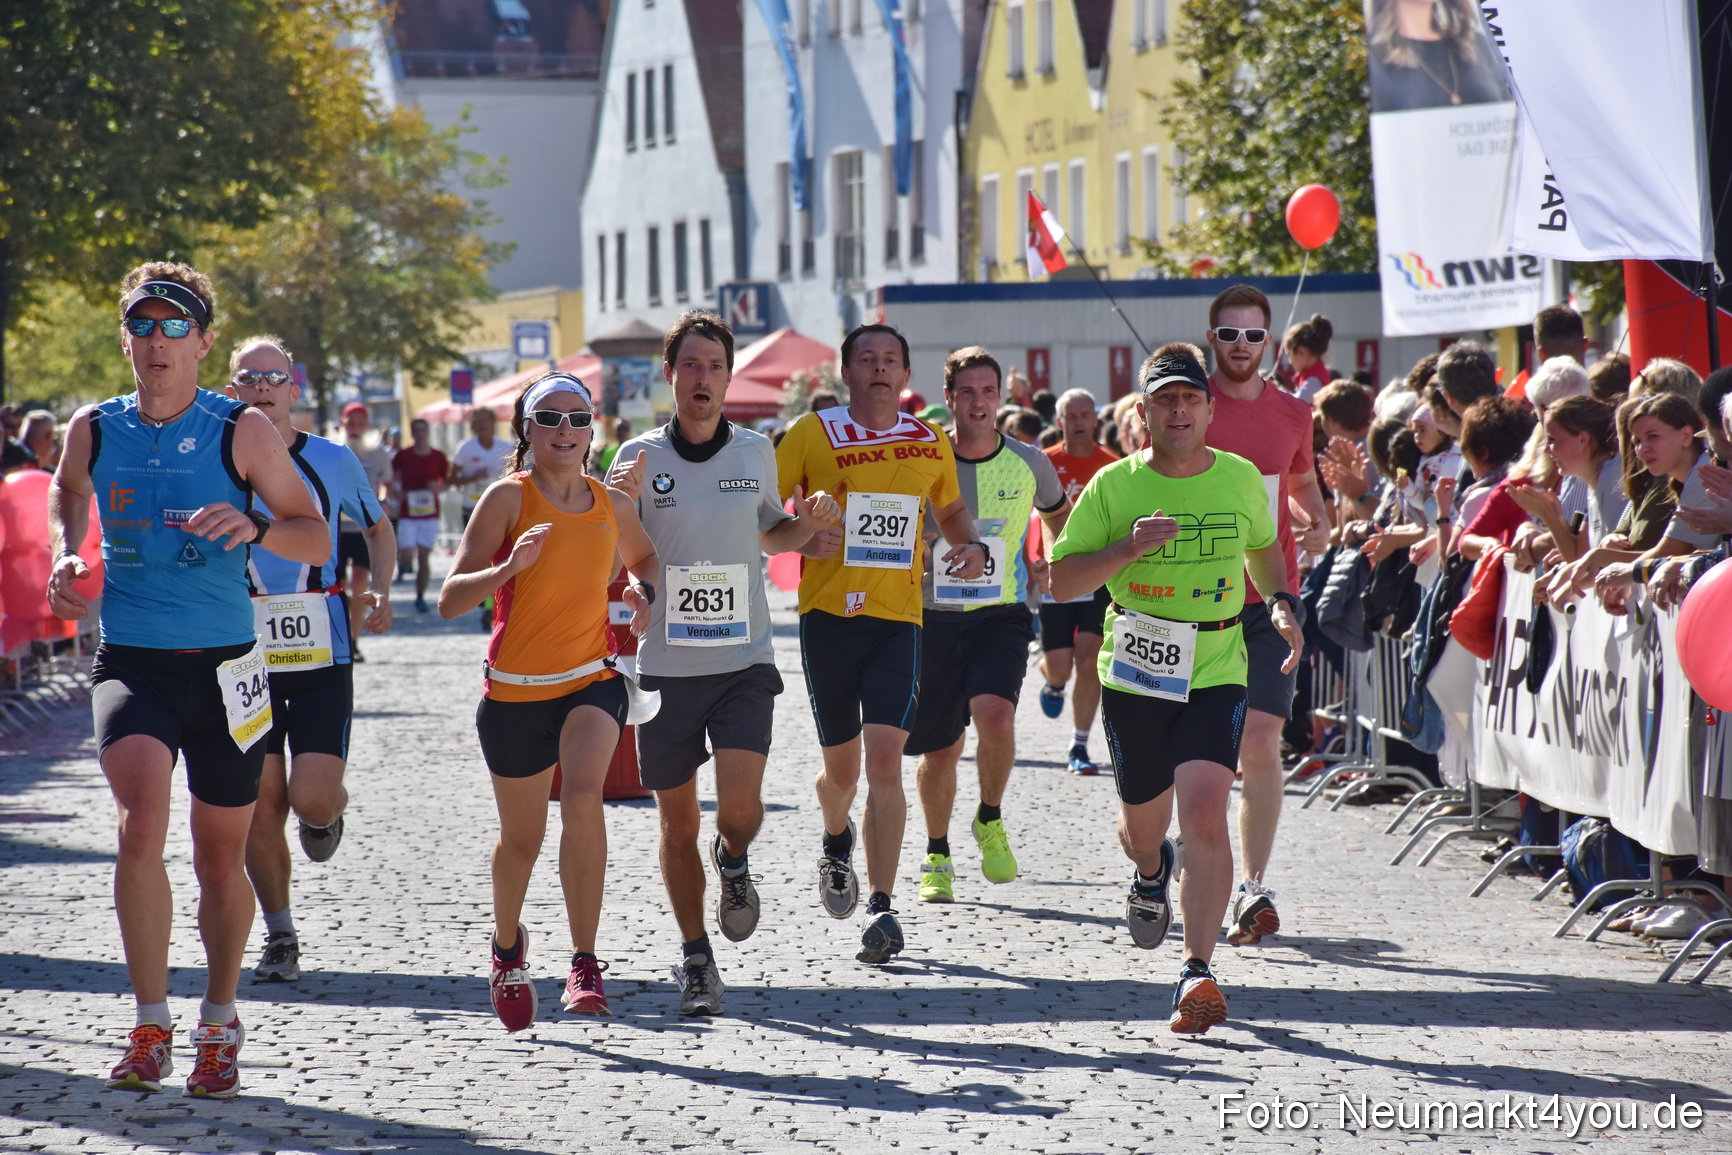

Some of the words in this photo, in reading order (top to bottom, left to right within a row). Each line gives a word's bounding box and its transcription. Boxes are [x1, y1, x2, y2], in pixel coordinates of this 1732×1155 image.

[835, 449, 888, 469] MAX
[893, 444, 944, 461] BÖGL
[719, 479, 760, 489] BOCK
[654, 497, 677, 505] PARTL
[870, 500, 903, 510] BOCK
[857, 513, 909, 538] 2397
[865, 549, 901, 561] Andreas
[690, 572, 727, 582] BOCK
[961, 588, 979, 597] Ralf
[1128, 581, 1176, 598] MERZ
[268, 601, 306, 612] BOCK
[678, 586, 735, 613] 2631
[266, 615, 310, 640] 160
[687, 625, 730, 638] Veronika
[1135, 619, 1171, 637] BOCK
[1123, 632, 1181, 666] 2558
[269, 653, 313, 665] Christian
[1128, 657, 1144, 668] PARTL
[1143, 664, 1167, 674] Neumarkt
[1135, 671, 1161, 689] Klaus
